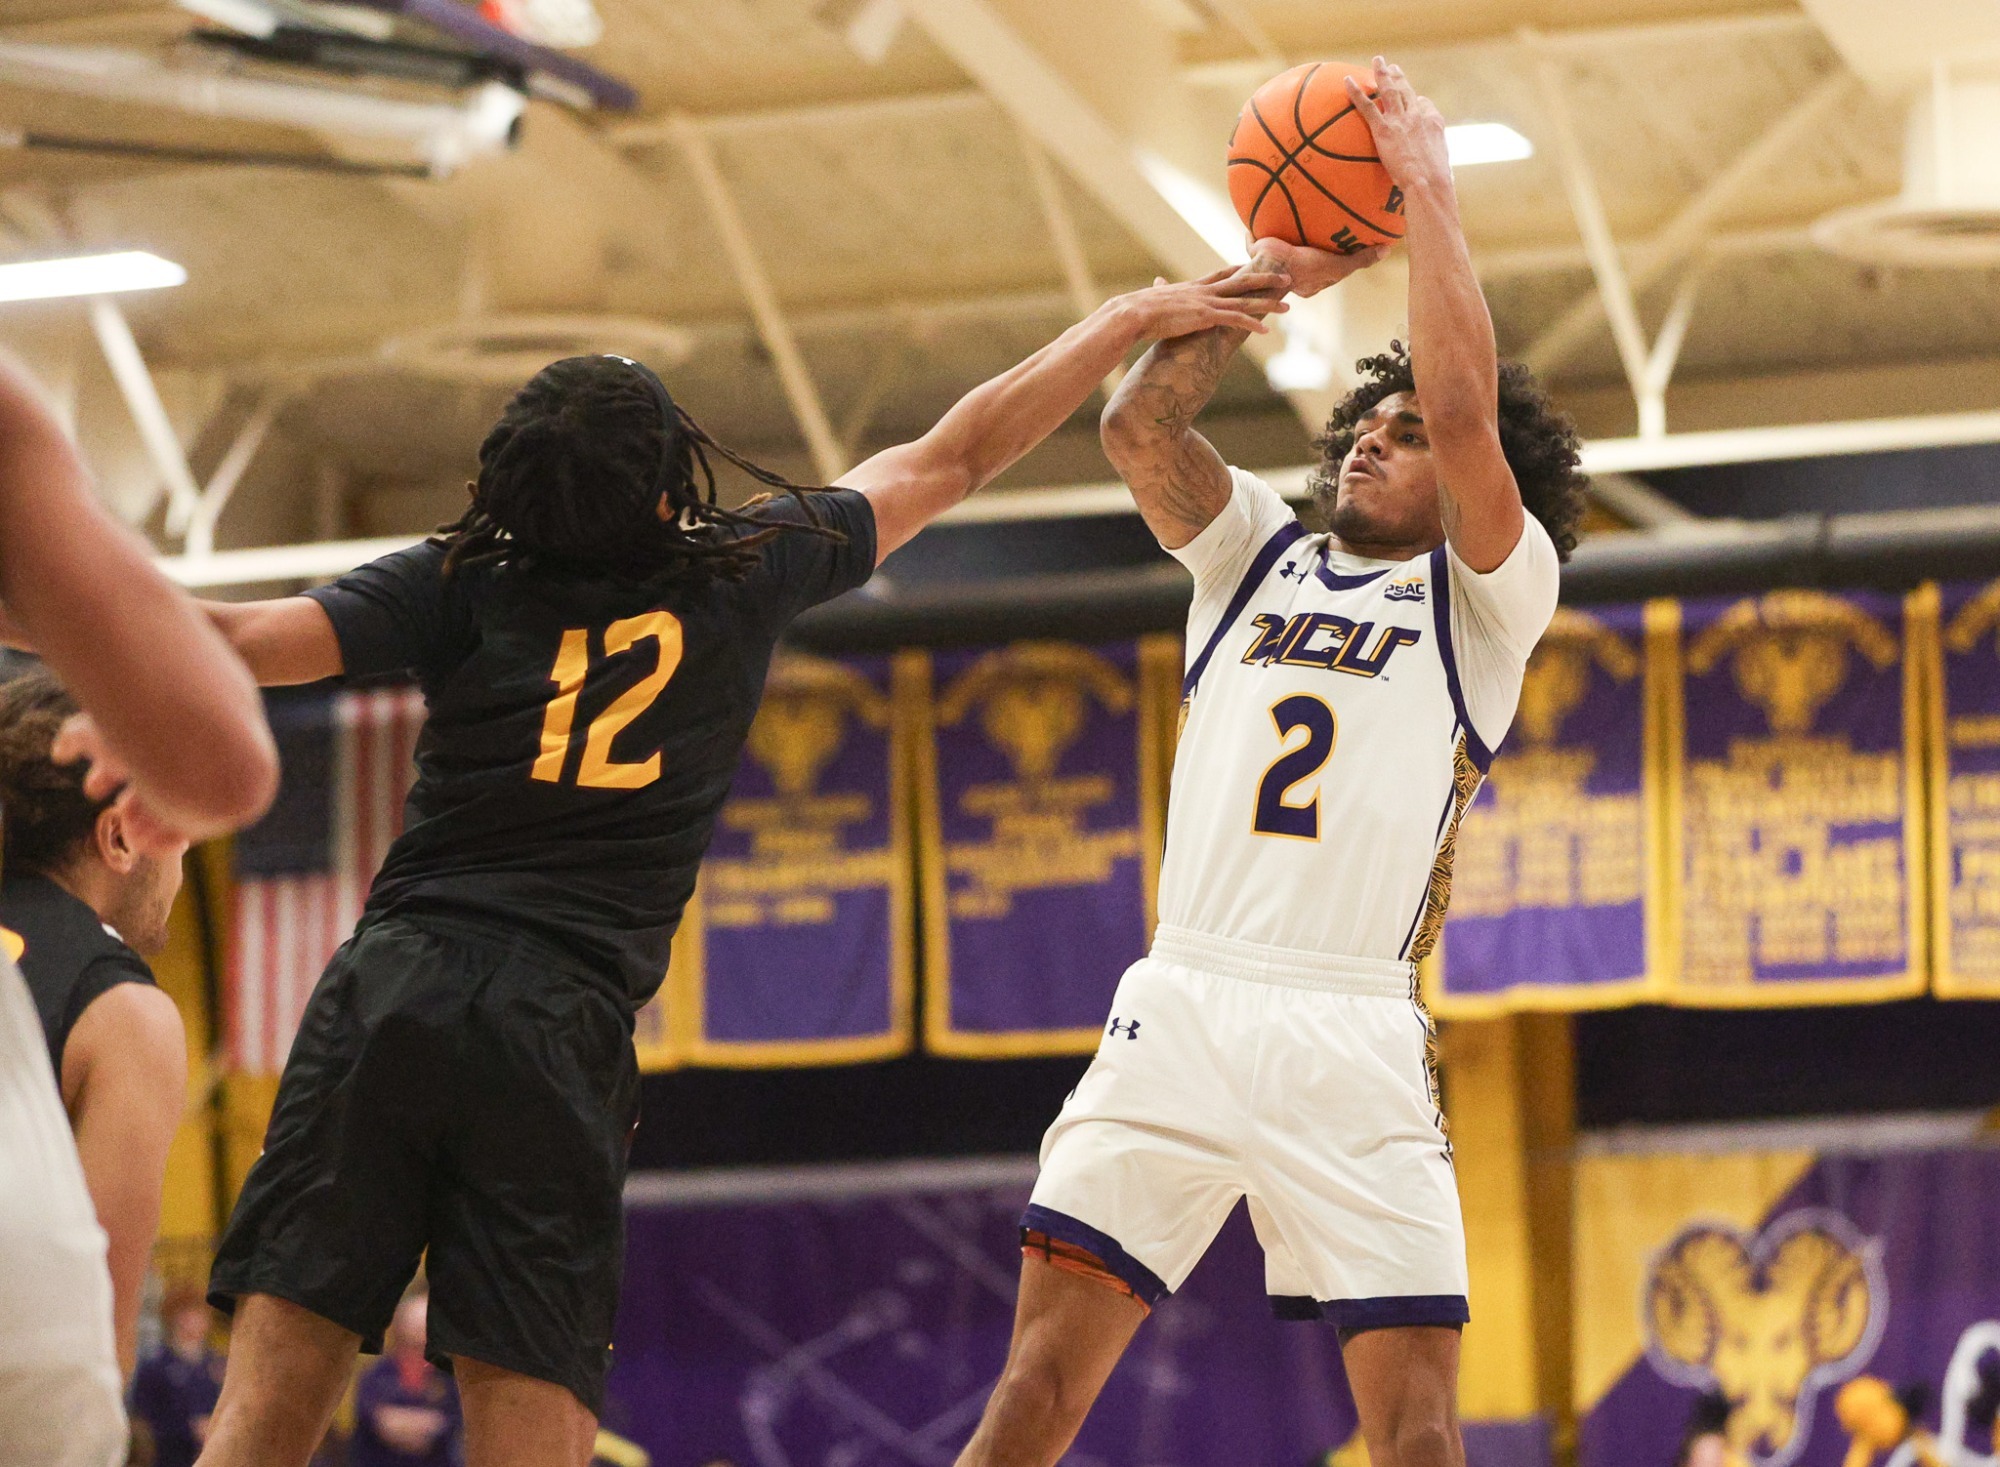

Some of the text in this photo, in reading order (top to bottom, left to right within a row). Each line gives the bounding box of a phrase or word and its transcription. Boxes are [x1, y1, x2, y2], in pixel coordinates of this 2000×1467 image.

[1384, 583, 1425, 596] PSAC
[530, 610, 683, 789] 12
[1240, 612, 1422, 679] WCU
[1250, 691, 1339, 843] 2
